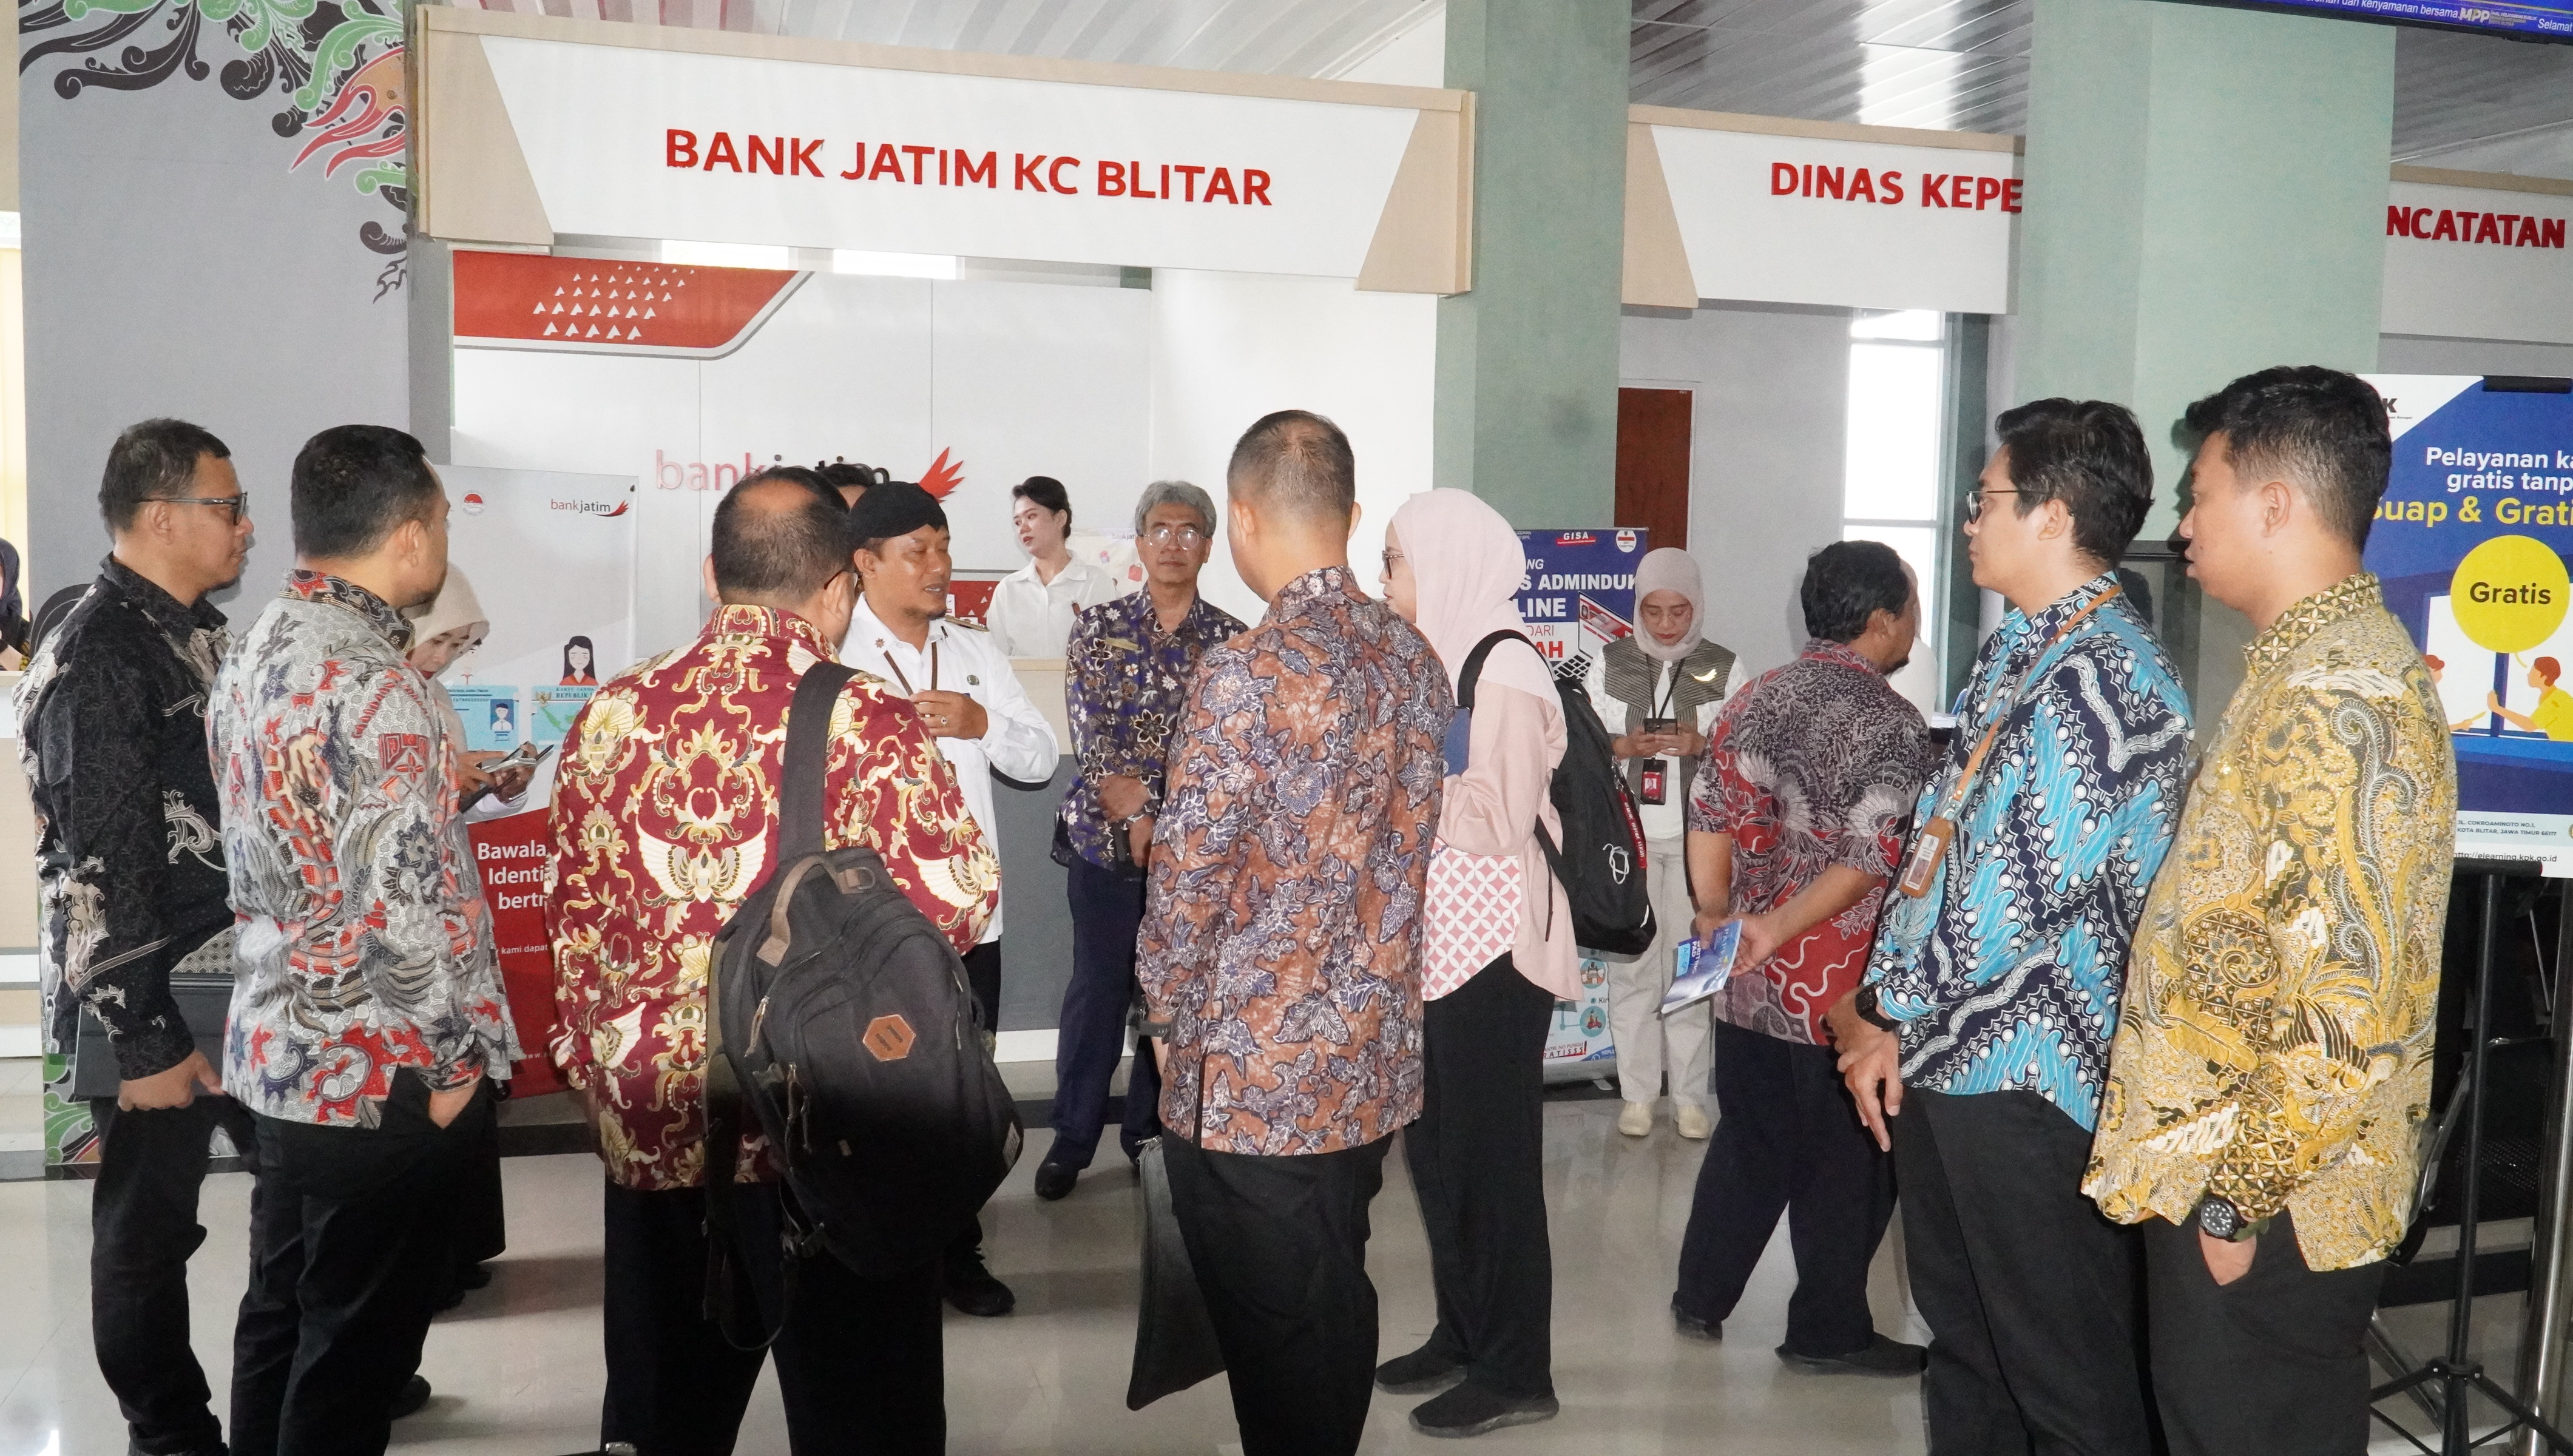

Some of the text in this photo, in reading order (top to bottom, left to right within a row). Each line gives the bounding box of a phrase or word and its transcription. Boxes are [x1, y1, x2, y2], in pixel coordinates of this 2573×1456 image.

[2361, 0, 2418, 14] kenyamanan
[2420, 6, 2460, 19] bersama.
[2459, 7, 2490, 23] MPP
[2538, 18, 2572, 32] Selamat
[667, 128, 1272, 206] BANK JATIM KC BLITAR
[1771, 162, 2023, 213] DINAS KEPE
[2386, 205, 2566, 249] NCATATAN
[2426, 447, 2573, 471] Pelayanan k
[2447, 470, 2573, 495] gratis tanp
[550, 499, 610, 514] bankjatim
[2458, 496, 2481, 522] &
[1563, 531, 1589, 541] GISA
[2469, 581, 2551, 605] Gratis
[1526, 625, 1554, 636] DARI
[478, 840, 546, 860] Bawala
[489, 864, 544, 885] Identi
[501, 944, 548, 954] kami dapat
